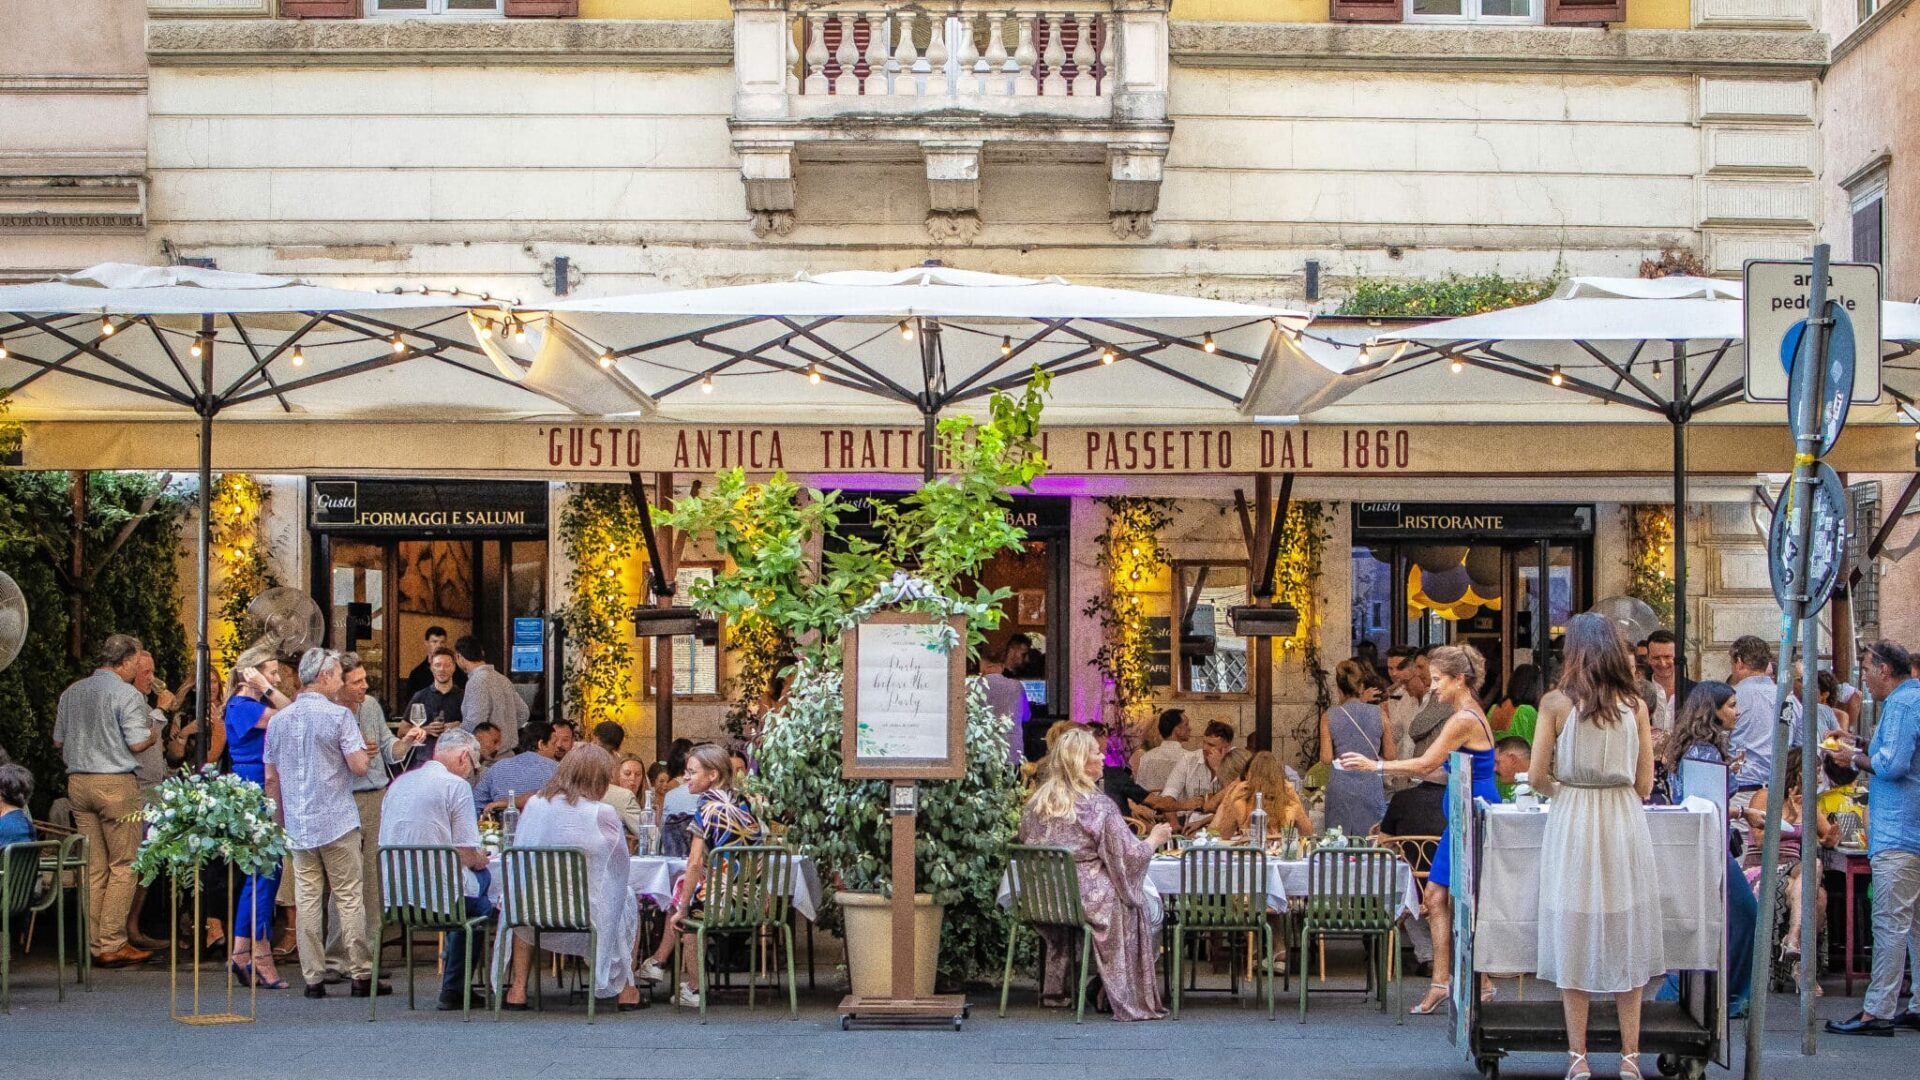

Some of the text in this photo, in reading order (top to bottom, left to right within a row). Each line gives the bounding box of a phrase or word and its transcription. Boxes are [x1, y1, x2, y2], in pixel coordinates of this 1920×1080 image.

[1793, 274, 1833, 287] ara
[1771, 294, 1856, 311] pedle
[674, 429, 784, 469] ANTICA
[1086, 430, 1232, 470] PASSETTO
[1260, 429, 1313, 469] DAL
[1343, 428, 1409, 469] 1860
[361, 511, 525, 526] FORMAGGI E SALUMI
[1005, 512, 1037, 526] BAR
[1405, 515, 1504, 529] RISTORANTE
[873, 671, 929, 692] before the
[887, 690, 921, 719] Party
